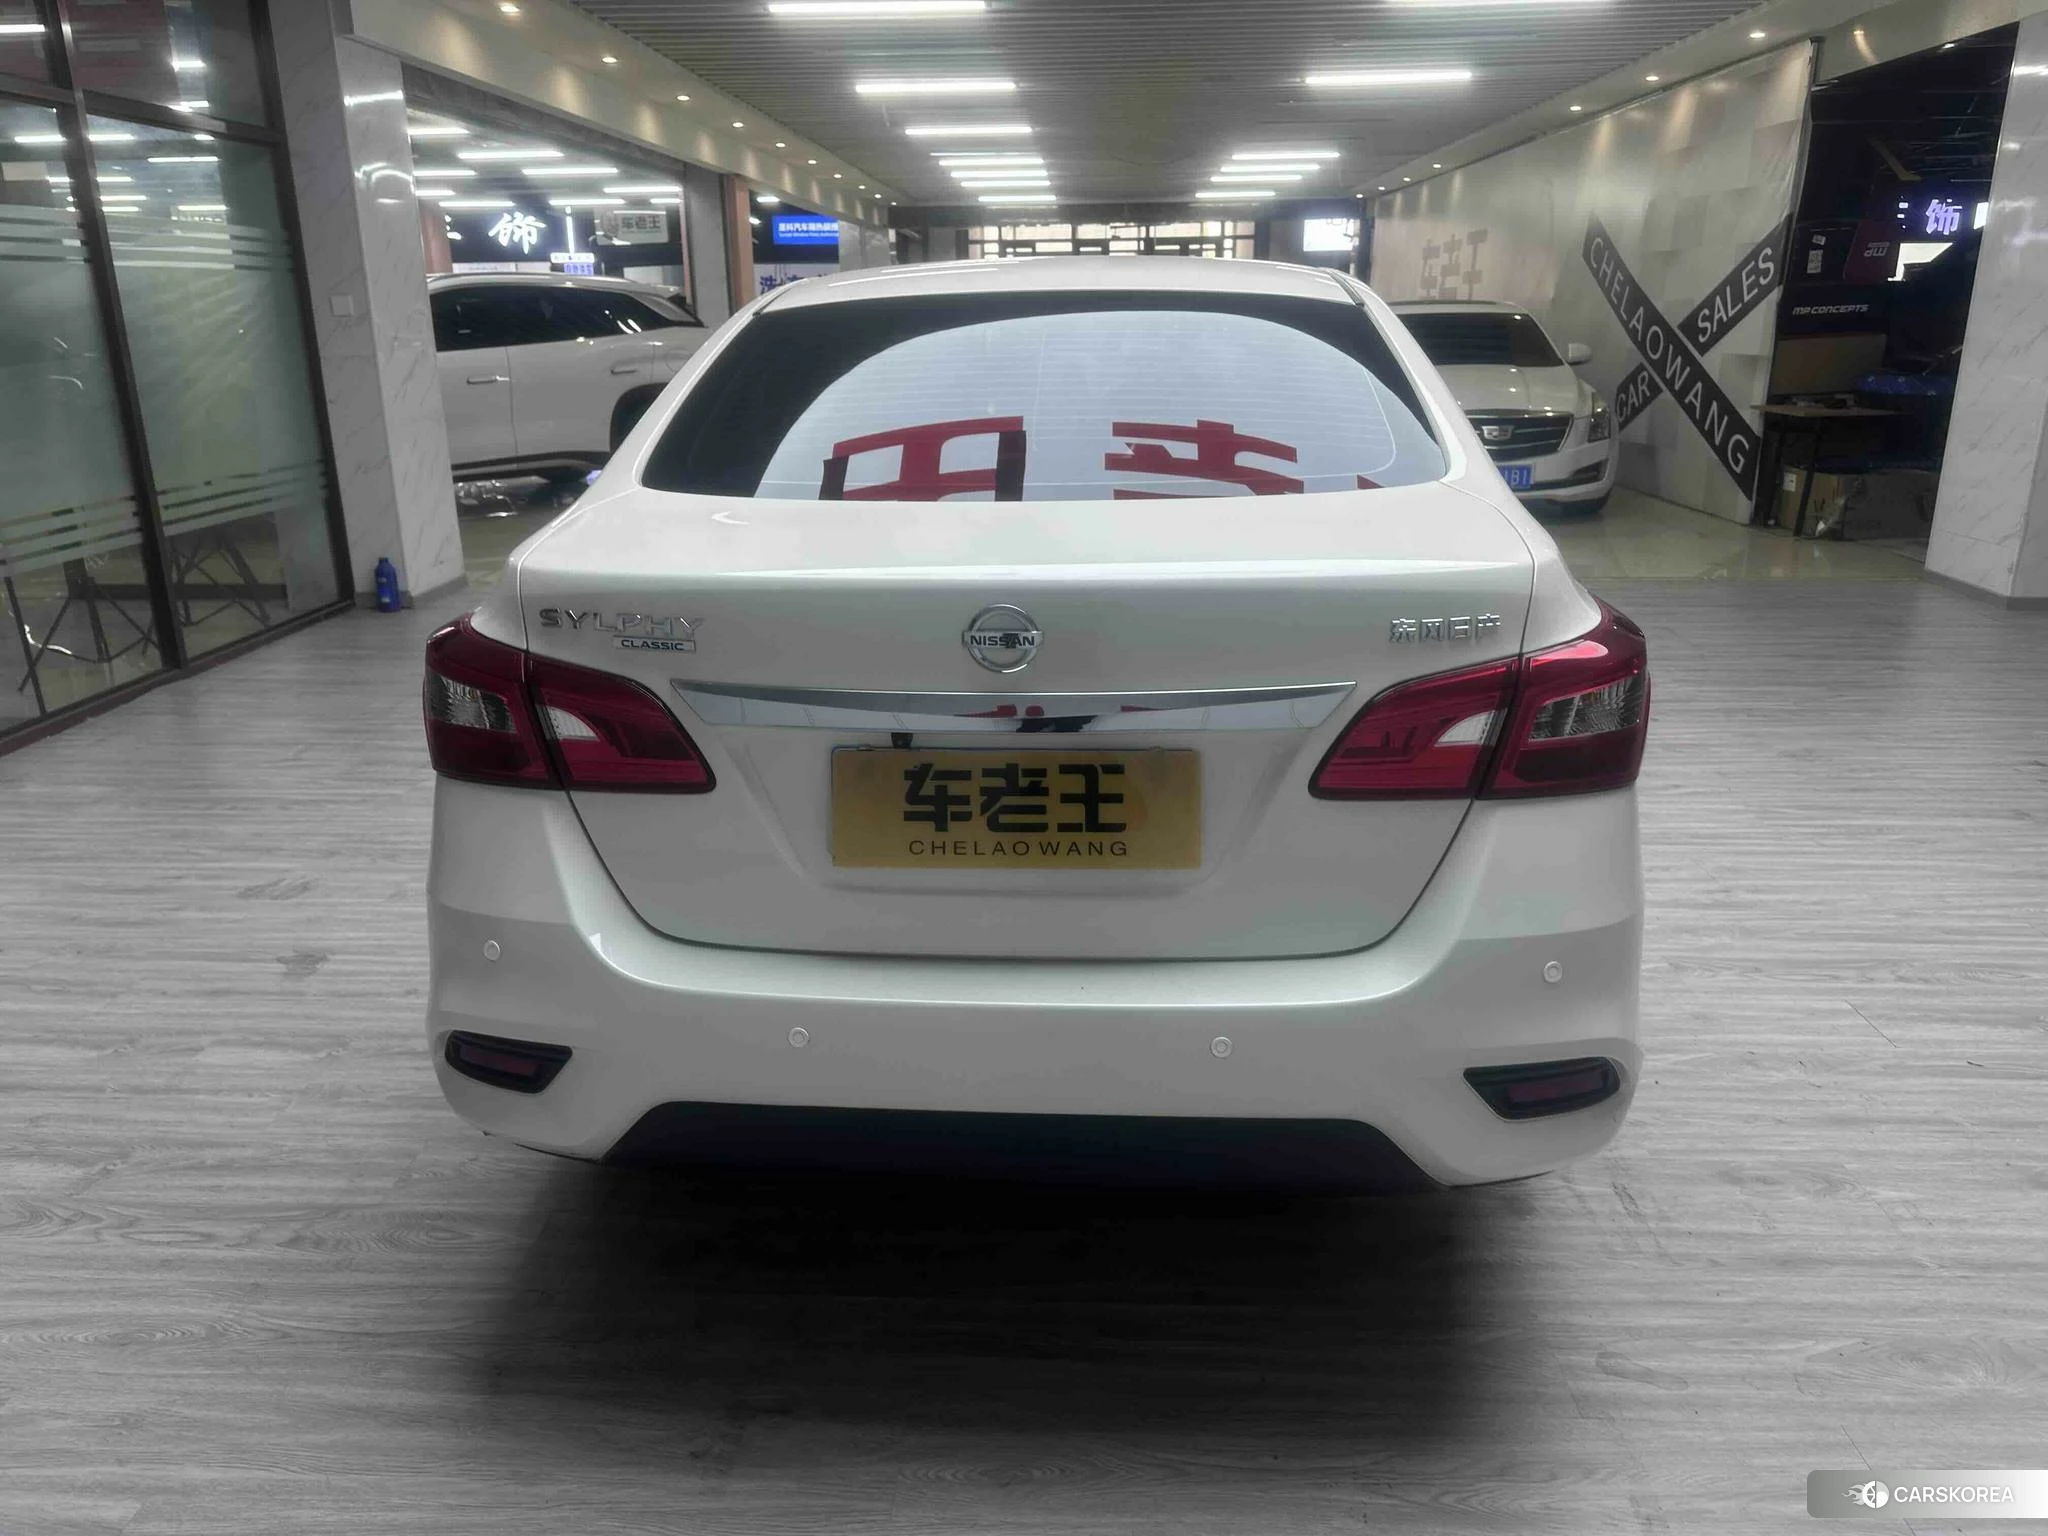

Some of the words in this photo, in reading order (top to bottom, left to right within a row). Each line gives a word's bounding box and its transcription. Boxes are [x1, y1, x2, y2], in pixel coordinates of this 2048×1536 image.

[1616, 370, 1650, 423] CAR
[1697, 247, 1775, 343] SALES
[1590, 237, 1749, 475] CHELAOWANG
[538, 607, 706, 637] SYLPHY
[620, 639, 685, 651] CLASSIC
[969, 634, 1035, 648] NISSAN
[903, 763, 1127, 832] 车老王
[908, 840, 1128, 856] CHELAOWANG
